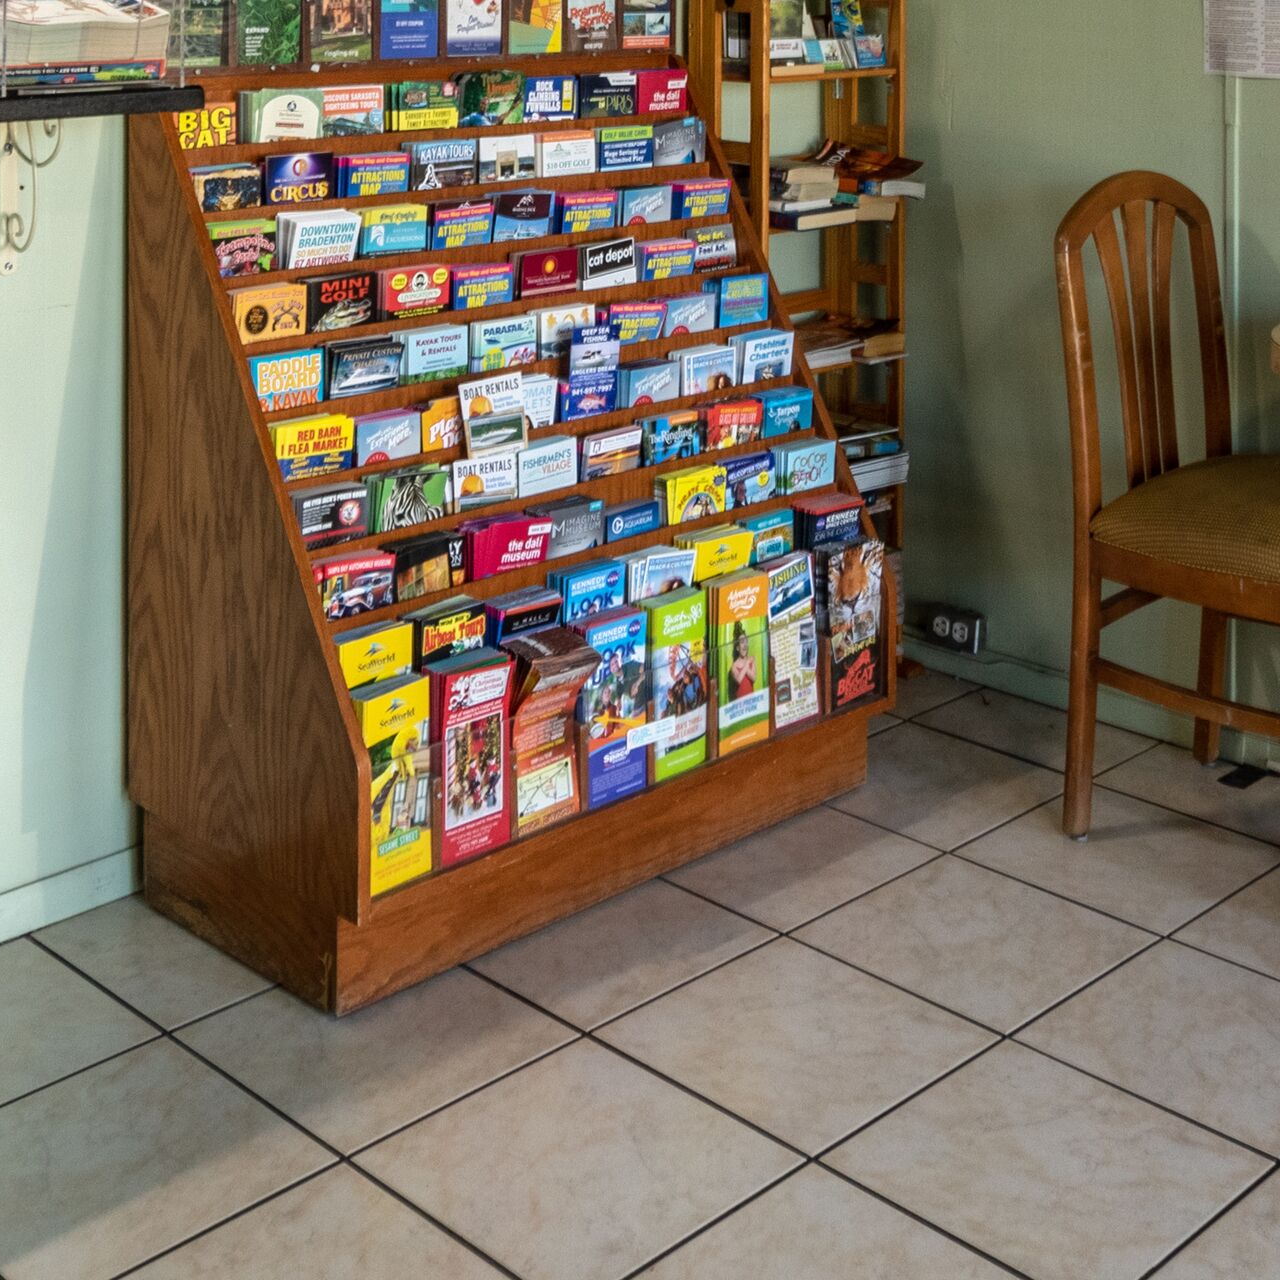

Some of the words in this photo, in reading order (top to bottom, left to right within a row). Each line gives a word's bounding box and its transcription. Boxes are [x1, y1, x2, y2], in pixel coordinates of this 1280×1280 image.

[536, 81, 554, 92] ROCK
[323, 90, 350, 102] DISCOVER
[351, 90, 380, 101] SARASOTA
[653, 91, 666, 102] the
[324, 100, 358, 112] SIGHTSEEING
[359, 100, 378, 109] TOURS
[526, 101, 560, 113] FUNWALLS
[649, 101, 680, 111] museum
[179, 107, 231, 134] BIG
[179, 127, 232, 150] CAT
[420, 146, 448, 162] KAYAK
[449, 144, 474, 158] TOURS
[559, 159, 572, 168] OFF
[573, 157, 591, 167] GOLF
[351, 170, 405, 184] ATTRACTIONS
[270, 182, 329, 203] CIRCUS
[360, 184, 381, 197] MAP
[565, 207, 612, 223] ATTRACTIONS
[691, 204, 708, 217] MAP
[300, 222, 357, 237] DOWNTOWN
[437, 220, 489, 237] ATTRACTIONS
[572, 220, 591, 232] MAP
[298, 234, 354, 249] BRADENTON
[445, 233, 466, 248] MAP
[698, 234, 711, 243] See
[308, 247, 326, 257] MUCH
[588, 254, 606, 268] cat
[605, 245, 633, 266] depot
[698, 246, 713, 256] Feel
[714, 243, 728, 252] Art.
[305, 253, 350, 267] ARTWORKS
[647, 255, 692, 270] ATTRACTIONS
[654, 268, 671, 280] MAP
[321, 277, 370, 293] MINI
[457, 278, 510, 298] ATTRACTIONS
[321, 289, 369, 303] GOLF
[466, 294, 487, 308] MAP
[482, 323, 526, 337] PARASAIL
[581, 328, 598, 337] DEEP
[599, 326, 610, 334] SEA
[416, 337, 439, 347] KAYAK
[440, 333, 462, 344] TOURS
[754, 339, 787, 352] Fishing
[343, 351, 370, 361] PRIVATE
[371, 346, 402, 356] CUSTOM
[427, 345, 457, 355] RENTALS
[749, 348, 790, 362] Charters
[257, 355, 320, 376] PADDLE
[257, 371, 320, 394] BOARD
[463, 384, 483, 400] BOAT
[484, 378, 519, 395] RENTALS
[259, 398, 272, 412] &
[272, 389, 319, 411] KAYAK
[297, 430, 315, 443] RED
[317, 426, 342, 440] BARN
[662, 426, 693, 444] Ringling
[288, 443, 312, 457] FLEA
[313, 437, 347, 452] MARKET
[522, 448, 571, 470] FISHERMEN'S
[457, 465, 477, 478] BOAT
[478, 458, 512, 475] RENTALS
[541, 460, 571, 474] VILLAGE
[623, 514, 653, 529] AQUARIUM
[826, 510, 860, 523] KENNEDY
[508, 538, 524, 551] the
[501, 549, 541, 563] museum
[709, 553, 738, 567] SeaWorld
[769, 561, 806, 589] FISHING
[571, 575, 606, 591] KENNEDY
[571, 588, 588, 597] SPACE
[588, 584, 606, 594] CENTER
[570, 591, 615, 618] LOOK
[424, 623, 457, 653] Airboat
[458, 616, 486, 638] Tours
[593, 624, 627, 641] KENNEDY
[357, 652, 396, 671] SeaWorld
[379, 708, 415, 728] SeaWorld
[400, 829, 420, 848] STREET
